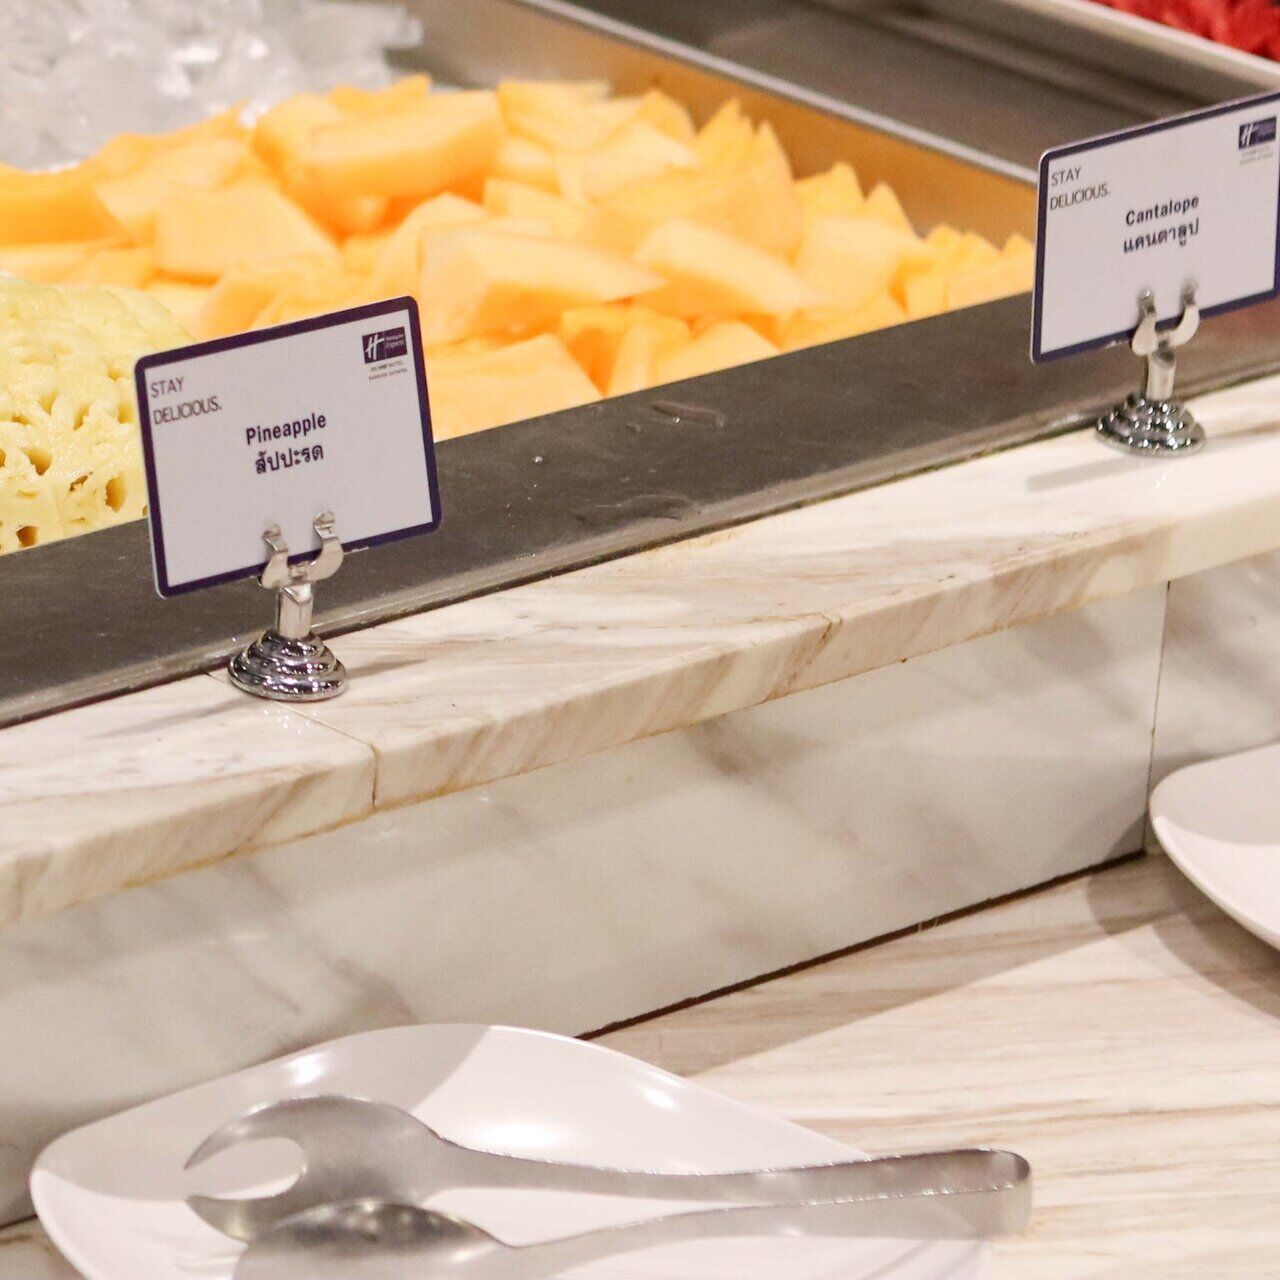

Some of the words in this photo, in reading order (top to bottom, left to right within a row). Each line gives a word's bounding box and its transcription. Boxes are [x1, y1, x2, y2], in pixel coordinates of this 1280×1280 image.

[1051, 166, 1082, 187] STAY
[1049, 183, 1110, 211] DELICIOUS.
[1125, 196, 1200, 226] Cantalope
[151, 376, 185, 398] STAY
[152, 395, 223, 425] DELICIOUS.
[245, 412, 327, 446] Pineapple
